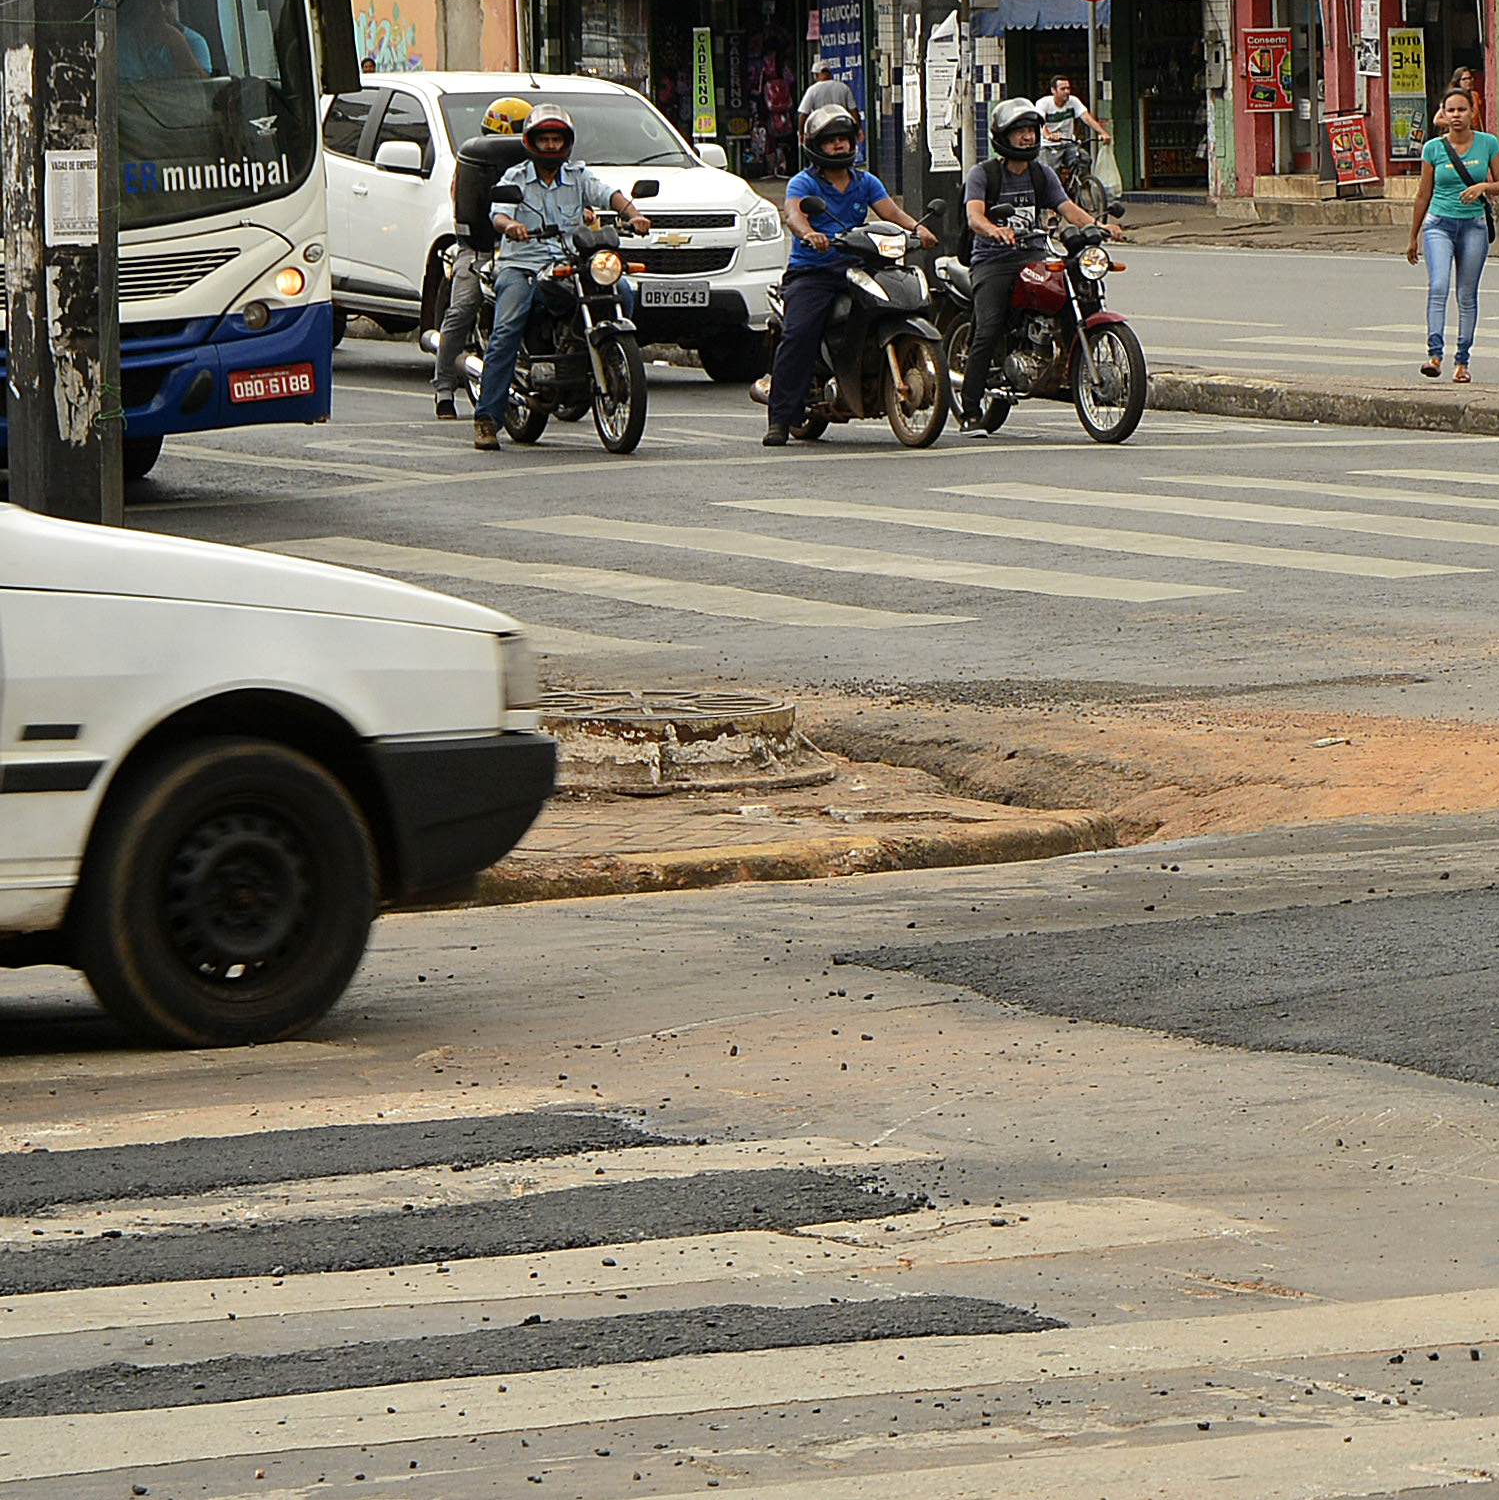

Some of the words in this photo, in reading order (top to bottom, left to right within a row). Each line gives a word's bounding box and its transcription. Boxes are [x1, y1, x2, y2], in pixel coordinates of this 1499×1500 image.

[1247, 36, 1287, 44] Conserto
[1391, 36, 1420, 46] FOTO
[697, 33, 709, 106] CADERNO
[76, 160, 97, 170] EMPREG
[162, 153, 290, 193] municipal
